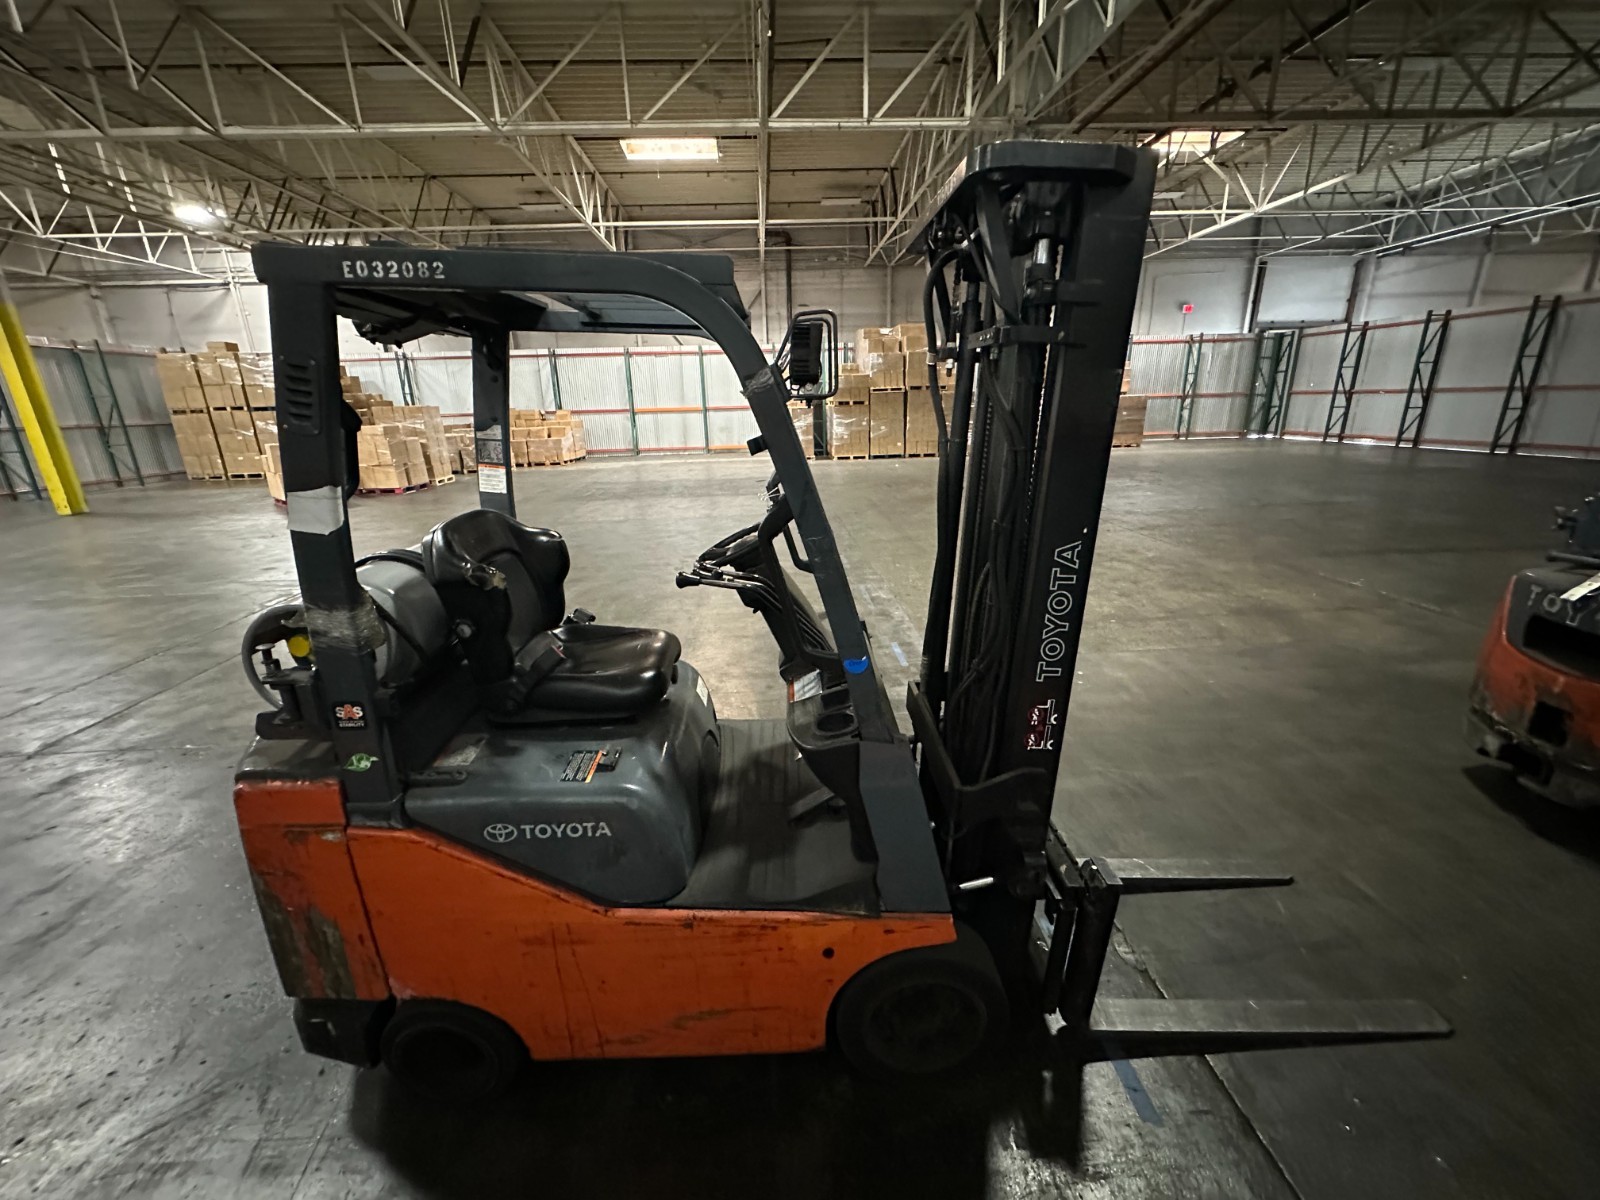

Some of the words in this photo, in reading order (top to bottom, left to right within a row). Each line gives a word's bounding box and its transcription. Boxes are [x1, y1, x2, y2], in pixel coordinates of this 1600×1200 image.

[342, 260, 446, 279] E032082
[1036, 540, 1082, 682] TOYOTA
[1524, 583, 1600, 626] TOY
[335, 703, 363, 719] SAS
[520, 822, 612, 839] TOYOTA
